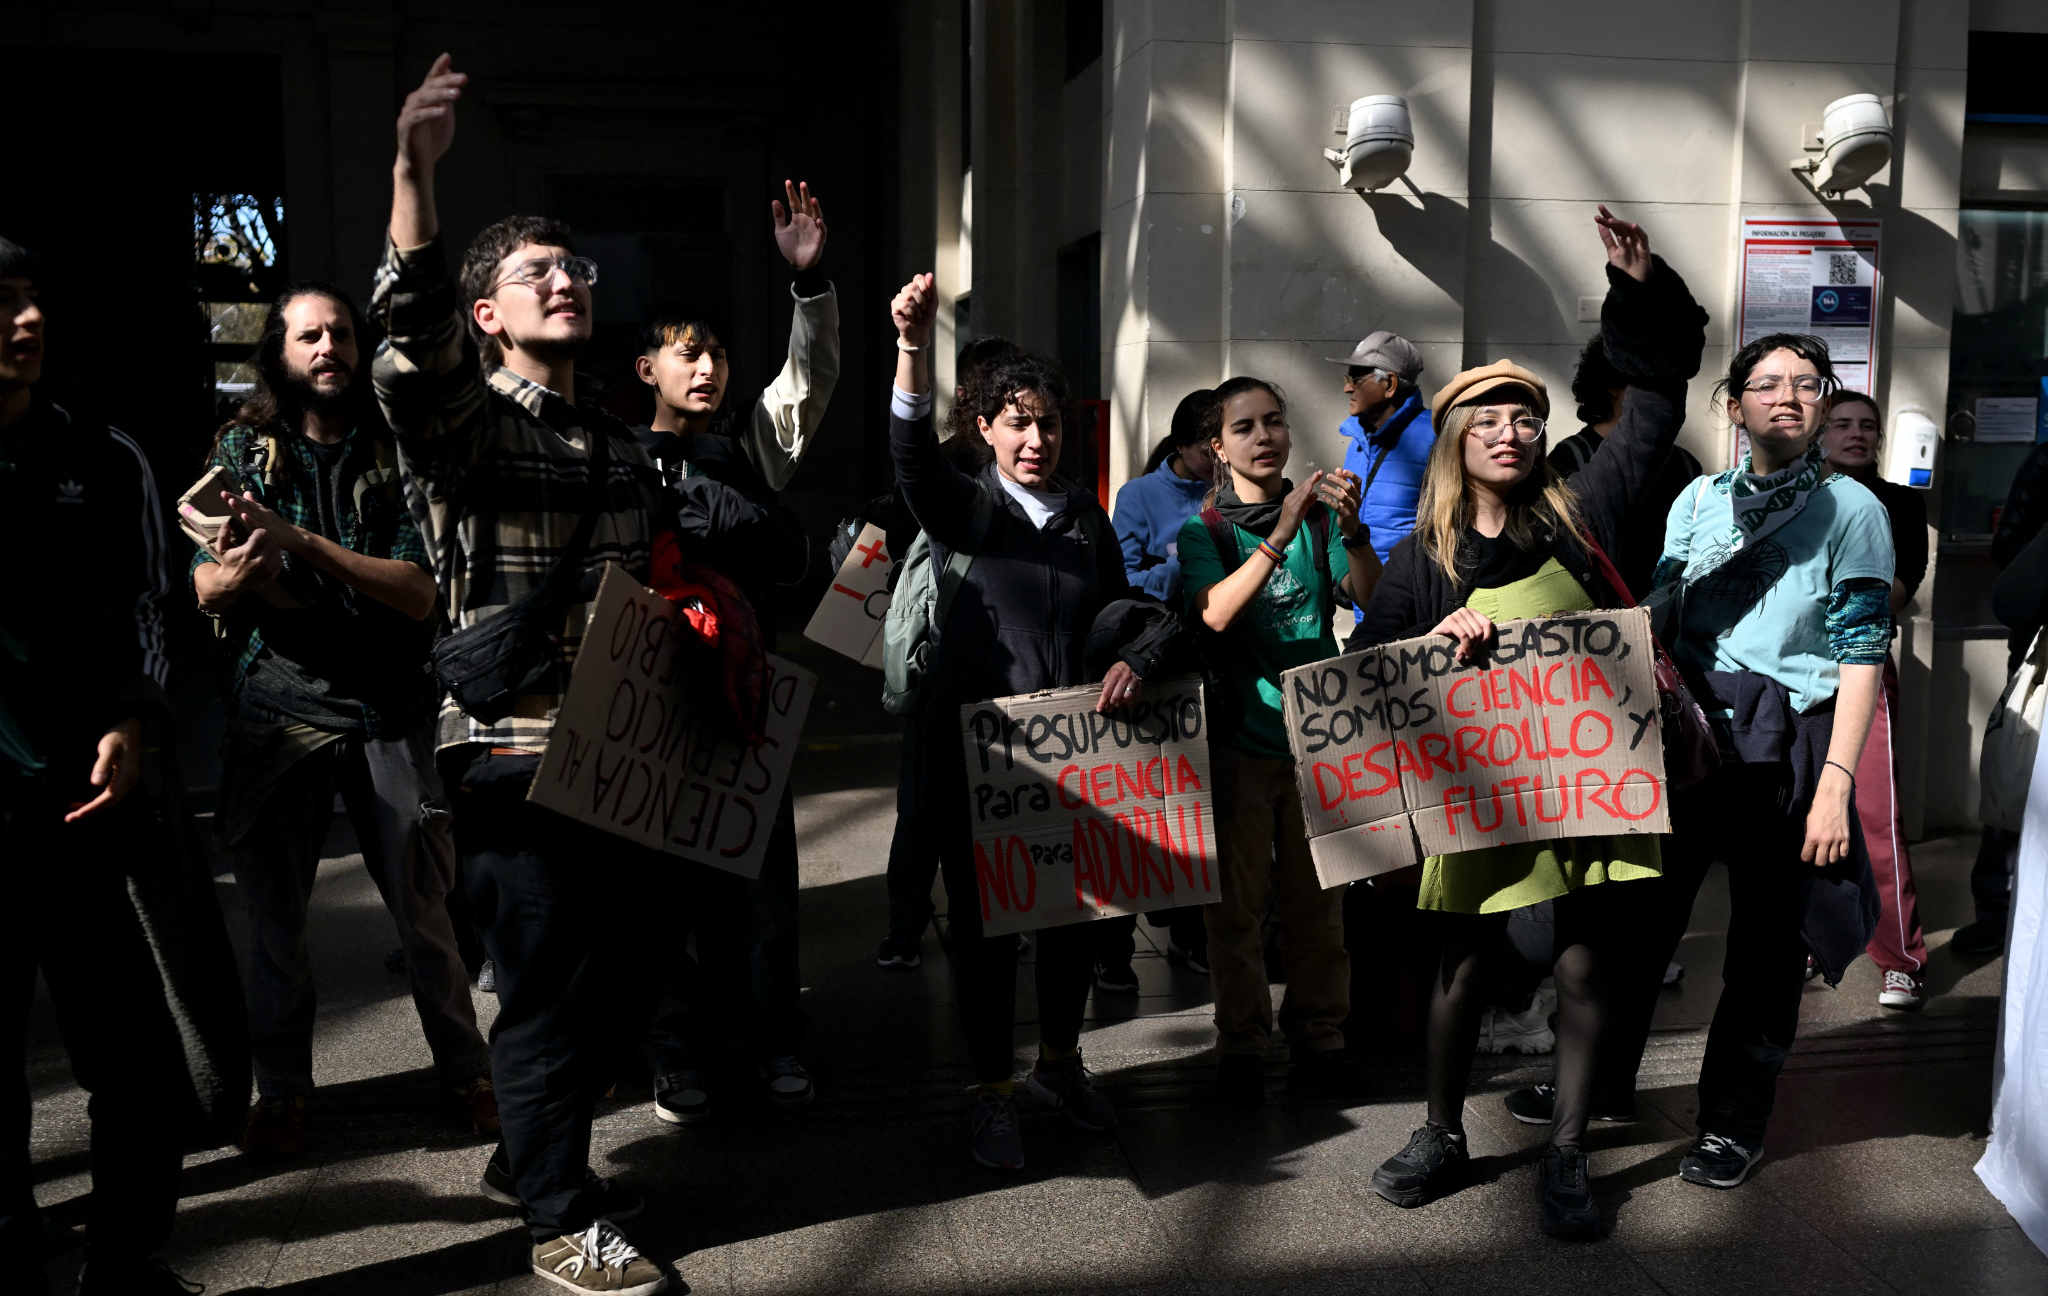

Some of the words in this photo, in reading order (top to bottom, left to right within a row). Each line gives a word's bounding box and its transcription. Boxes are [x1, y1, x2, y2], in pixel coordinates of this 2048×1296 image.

[1294, 666, 1348, 716] NO
[1490, 617, 1632, 665] GASTO,
[558, 728, 591, 791] AL
[1301, 687, 1438, 754] SOMOS
[1311, 709, 1614, 811] DESARROLLO
[1627, 708, 1655, 751] Y
[593, 748, 757, 858] CIENCIA
[1056, 753, 1202, 811] CIENCIA
[1443, 767, 1661, 836] FUTURO
[974, 834, 1037, 921] NO
[1072, 801, 1211, 911] ADORNI
